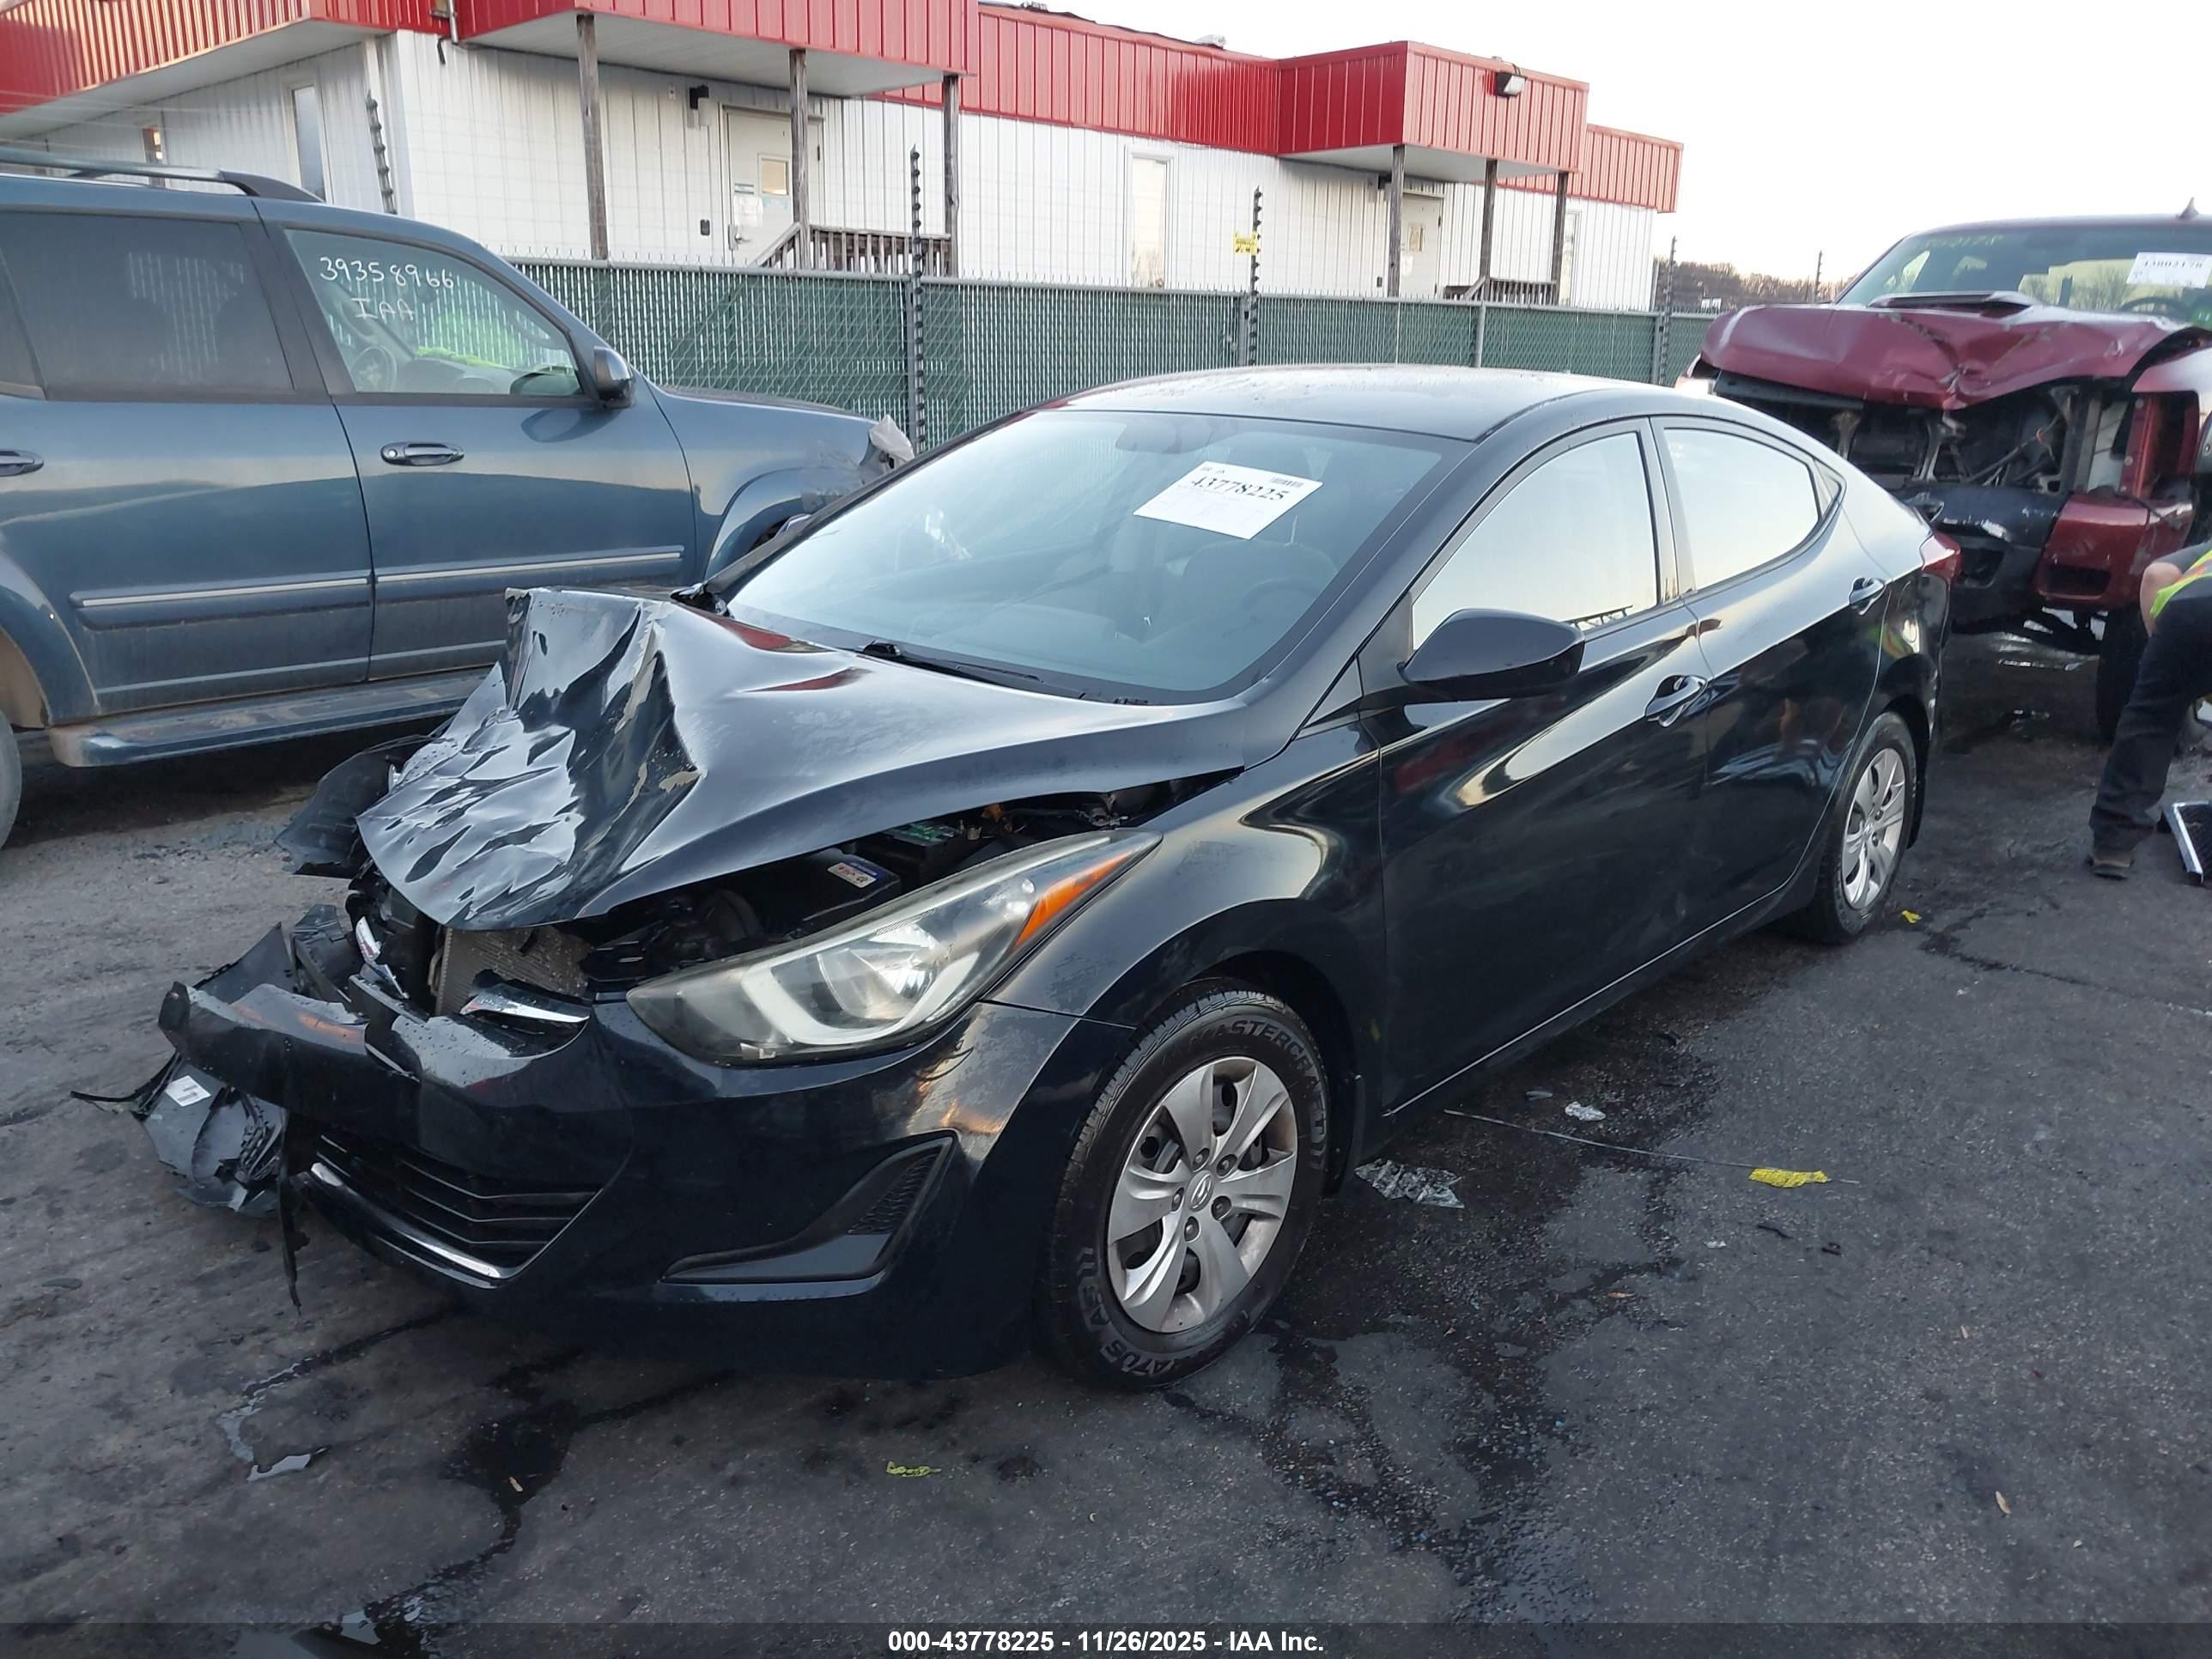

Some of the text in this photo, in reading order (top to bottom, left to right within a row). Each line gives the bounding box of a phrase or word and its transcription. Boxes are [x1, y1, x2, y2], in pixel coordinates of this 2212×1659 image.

[319, 257, 454, 289] 39358966
[350, 297, 416, 324] IAA
[1191, 476, 1290, 501] 43778225
